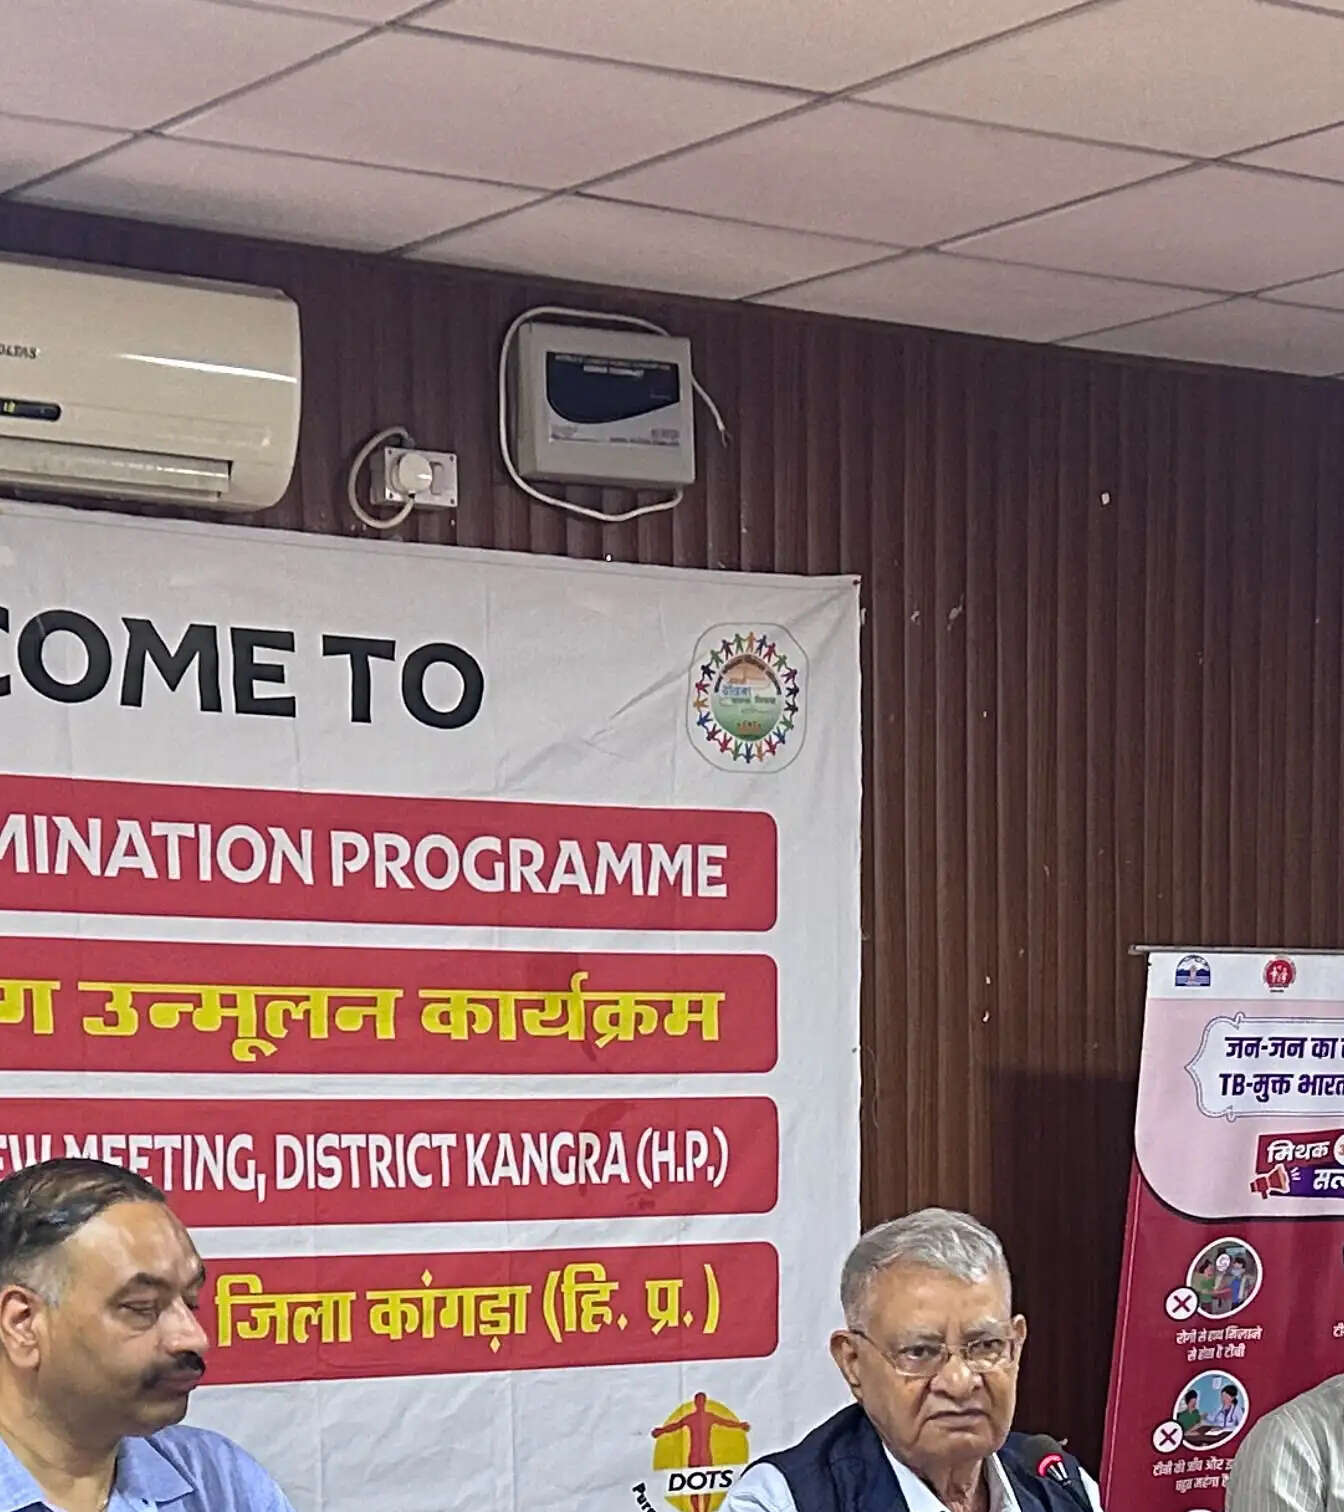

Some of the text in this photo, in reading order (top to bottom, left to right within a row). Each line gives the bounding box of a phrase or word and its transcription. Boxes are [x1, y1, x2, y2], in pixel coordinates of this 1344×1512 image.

[322, 633, 485, 730] TO
[331, 829, 728, 898] PROGRAMME
[78, 981, 404, 1062] उन्मूलन
[418, 972, 726, 1050] कार्यक्रम
[1224, 1035, 1307, 1060] जन-जन
[1311, 1035, 1336, 1060] का
[1219, 1073, 1292, 1102] TB-मुक्त
[276, 1132, 457, 1190] DISTRICT
[464, 1131, 630, 1186] KANGRA
[636, 1126, 730, 1188] (H.P.)
[1267, 1140, 1330, 1164] मिथक
[215, 1273, 359, 1348] जिला
[366, 1268, 532, 1353] कांगड़ा
[542, 1262, 628, 1343] (हि.
[668, 1470, 734, 1492] DOTS
